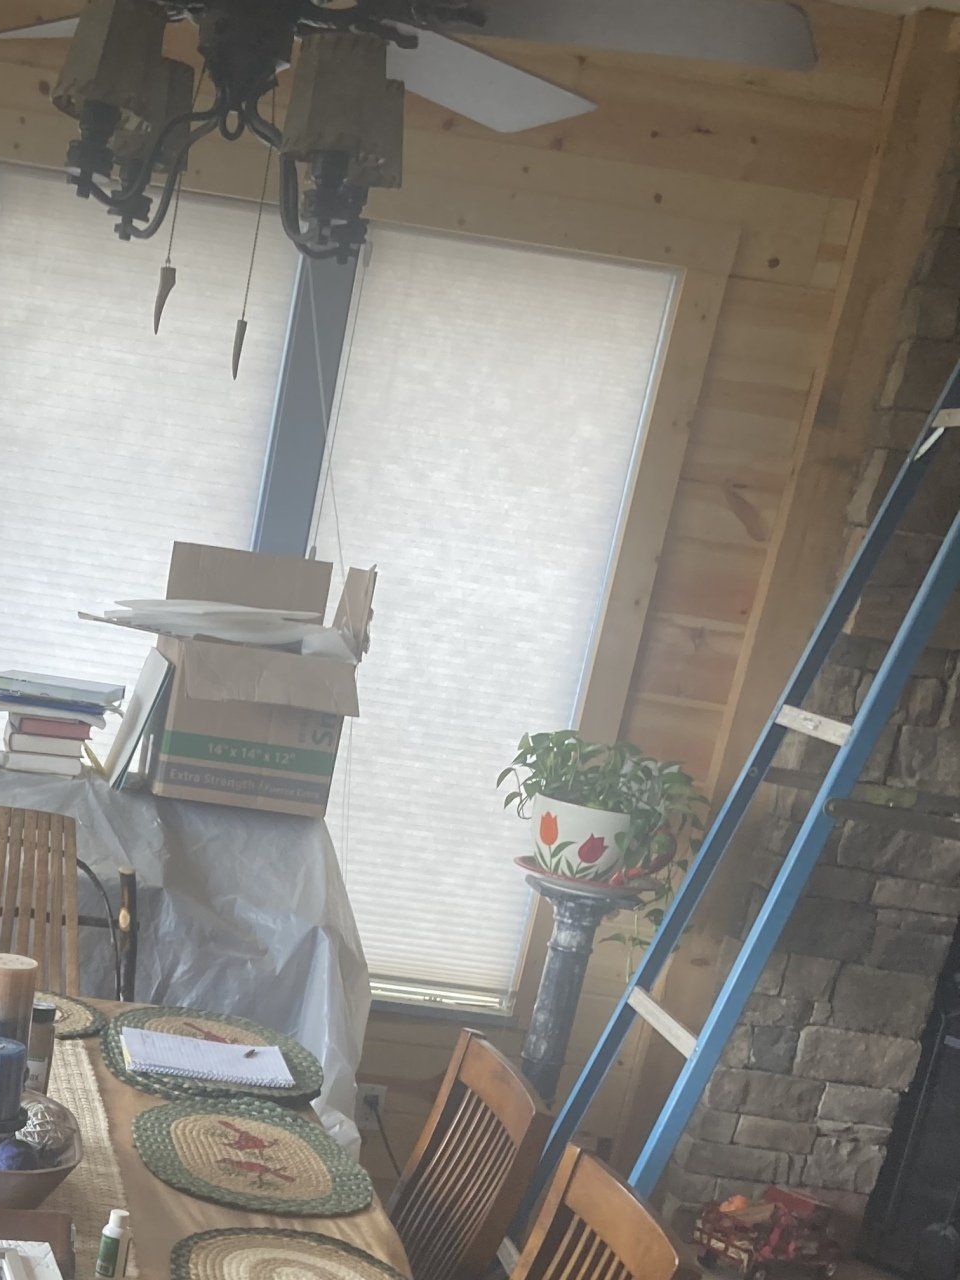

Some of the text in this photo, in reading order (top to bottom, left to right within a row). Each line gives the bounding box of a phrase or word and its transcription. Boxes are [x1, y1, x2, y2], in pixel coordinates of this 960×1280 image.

[208, 743, 296, 764] 14" x 14" x 12"
[169, 768, 200, 783] Extra
[203, 773, 256, 793] Strength
